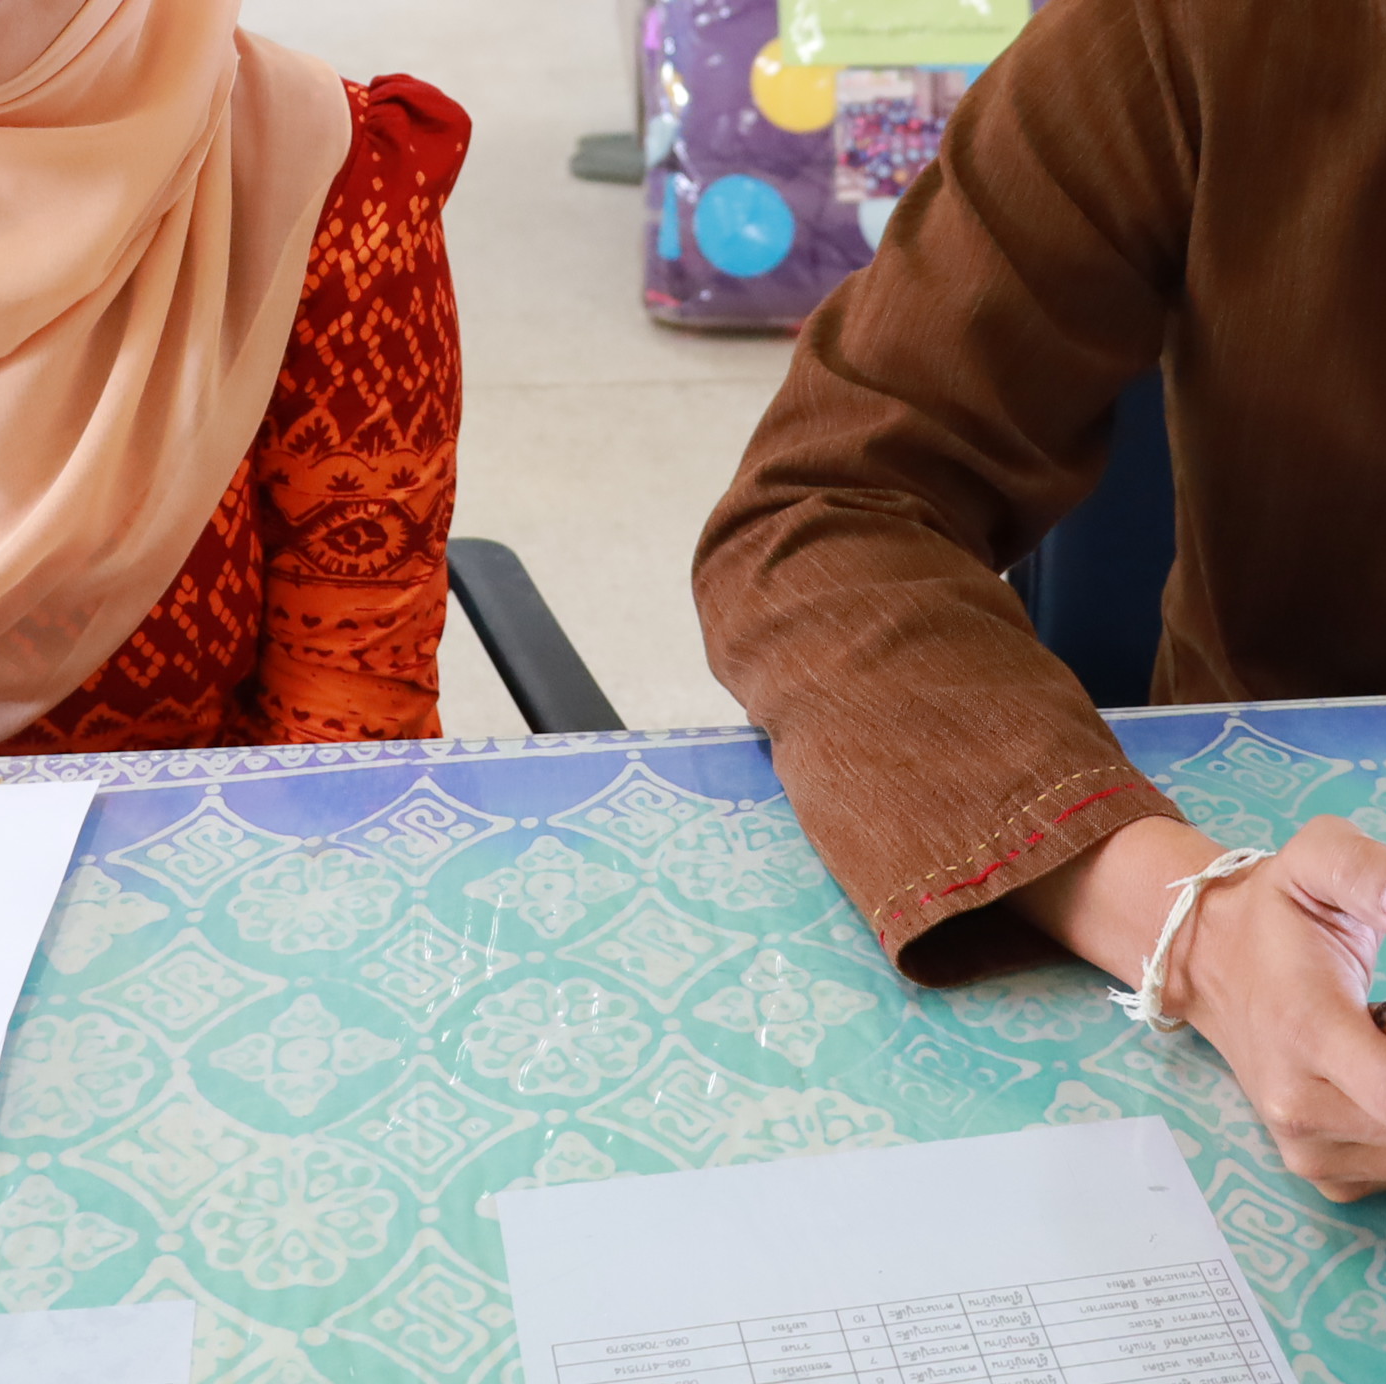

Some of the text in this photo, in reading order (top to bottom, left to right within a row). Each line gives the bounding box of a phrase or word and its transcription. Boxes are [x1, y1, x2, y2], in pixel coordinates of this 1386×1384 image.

[1206, 1266, 1220, 1277] 21
[967, 1289, 1023, 1308] ผู้ใหญ่บ้าน
[1214, 1286, 1232, 1297] 20
[851, 1313, 866, 1324] 10
[887, 1302, 954, 1320] ตาเนาะปูเต๊ะ
[974, 1310, 1032, 1328] ผู้ใหญ่บ้าน
[1225, 1306, 1240, 1317] 19
[861, 1334, 871, 1344] 8
[895, 1322, 962, 1341] ตาเนาะปูเต๊ะ
[982, 1331, 1040, 1349] ผู้ใหญ่บ้าน
[1235, 1327, 1250, 1338] 18
[869, 1355, 878, 1365] 7
[901, 1343, 970, 1362] ตาเนาะปูเต๊ะ
[1247, 1348, 1261, 1360] 17
[613, 1357, 691, 1376] 098-4171514
[990, 1352, 1049, 1375] ผู้ใหญ่บ้าน
[908, 1364, 977, 1383] ตาเนาะปูเต๊ะ
